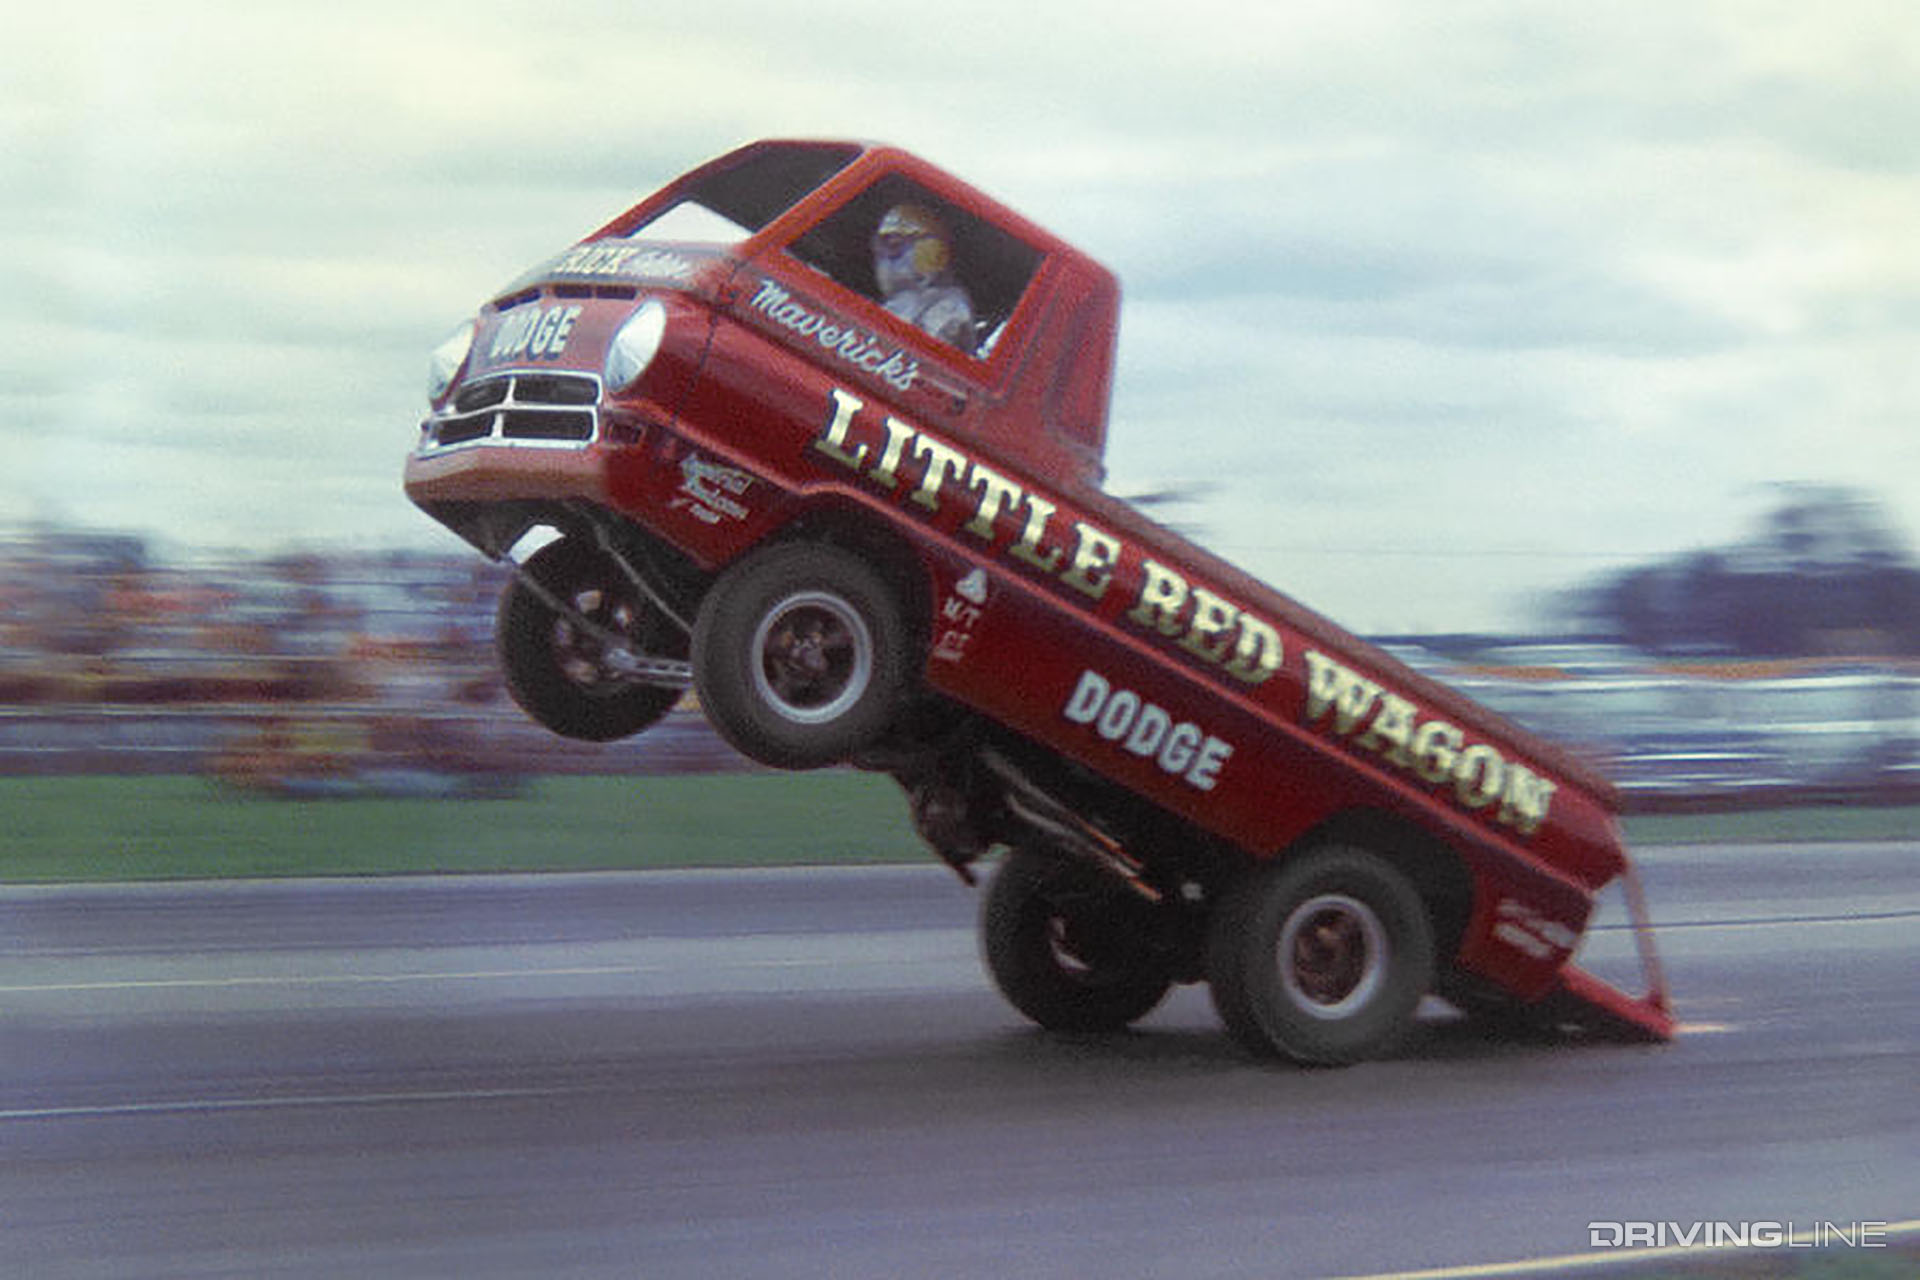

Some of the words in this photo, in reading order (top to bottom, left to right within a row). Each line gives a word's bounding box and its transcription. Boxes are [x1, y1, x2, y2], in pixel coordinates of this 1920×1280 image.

[489, 305, 583, 361] DGE
[814, 386, 1122, 599] LITTLE
[1127, 558, 1284, 684] RED
[1303, 650, 1558, 835] WAGON
[1064, 669, 1234, 791] DODGE
